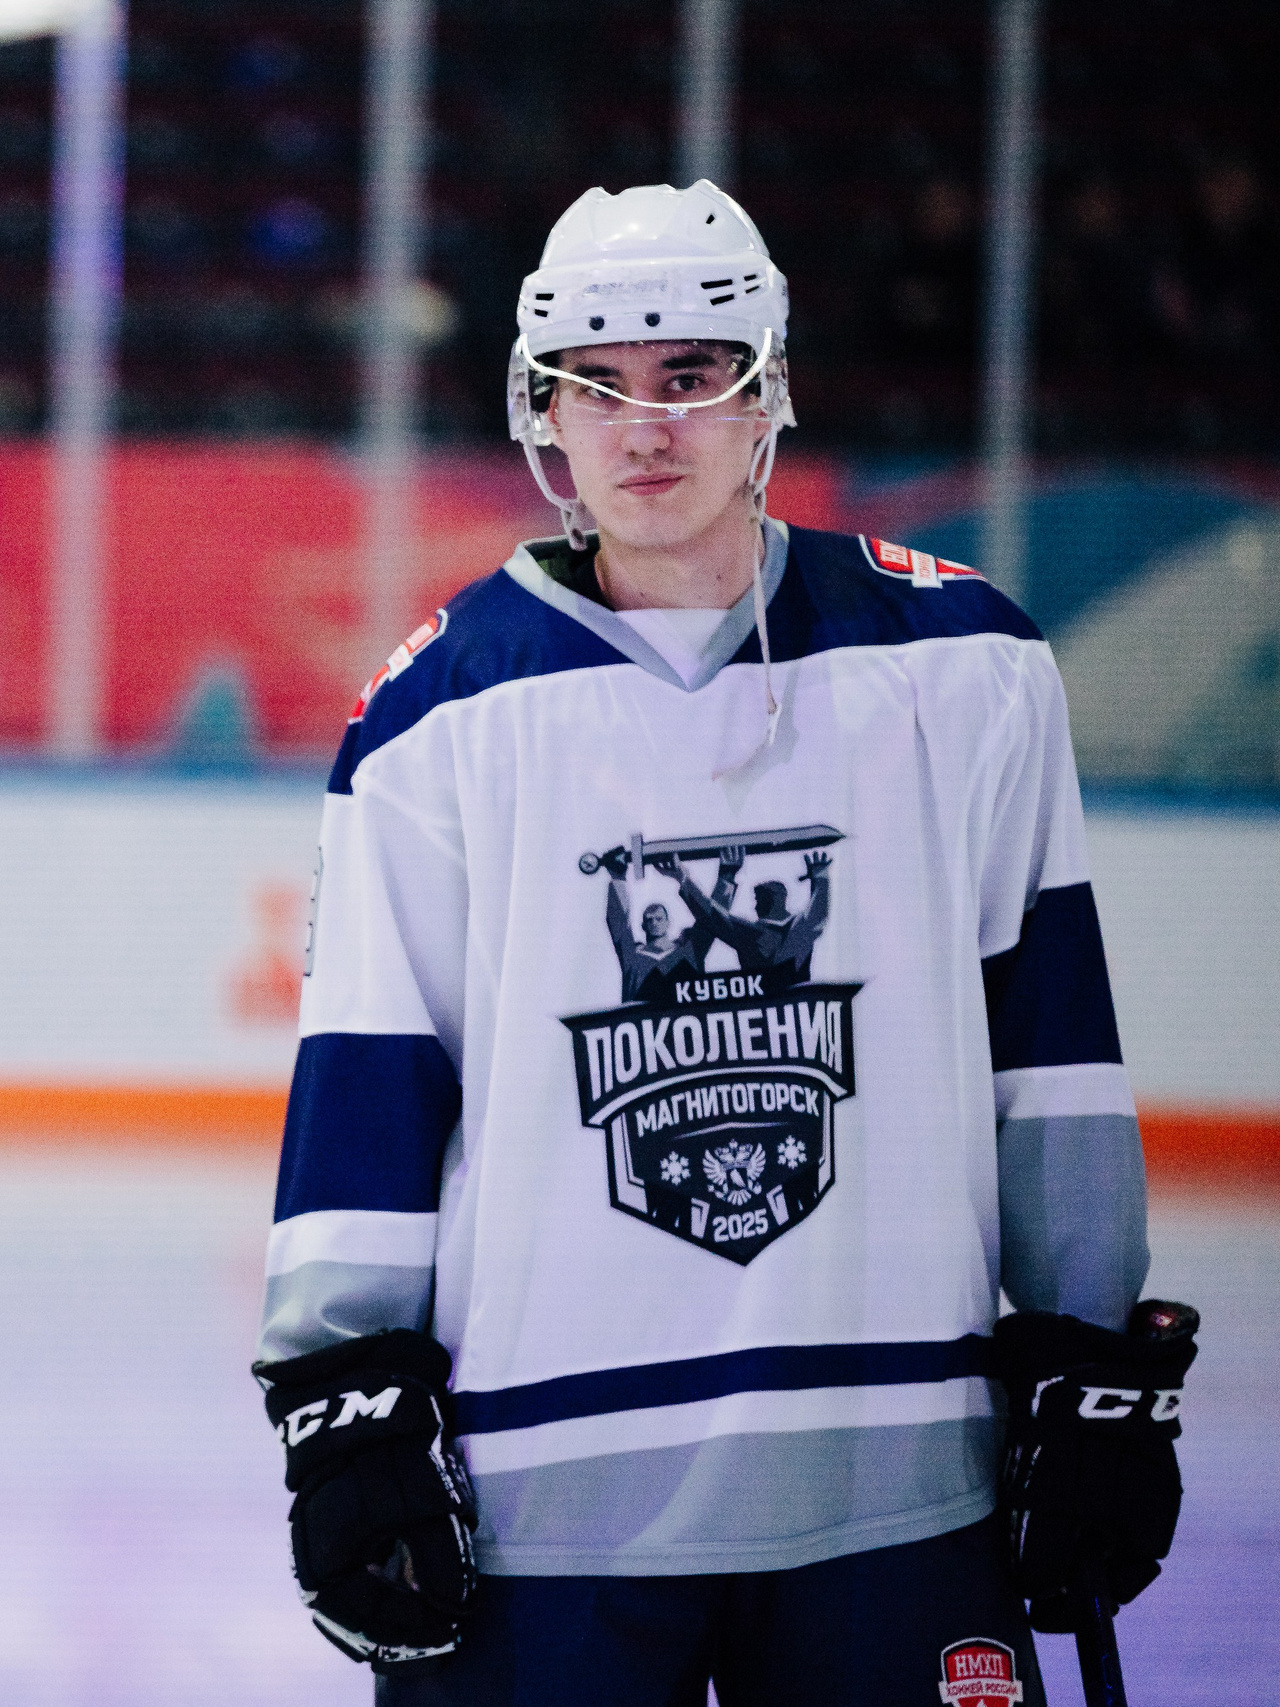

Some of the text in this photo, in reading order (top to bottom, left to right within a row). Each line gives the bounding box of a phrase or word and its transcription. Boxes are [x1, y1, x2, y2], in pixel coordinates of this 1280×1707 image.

[675, 974, 765, 1003] КУБОК
[581, 1000, 844, 1103] ПОКОЛЕНИЯ
[635, 1082, 821, 1138] МАГНИТОГОРСК
[712, 1208, 769, 1243] 2025
[274, 1386, 403, 1448] CM
